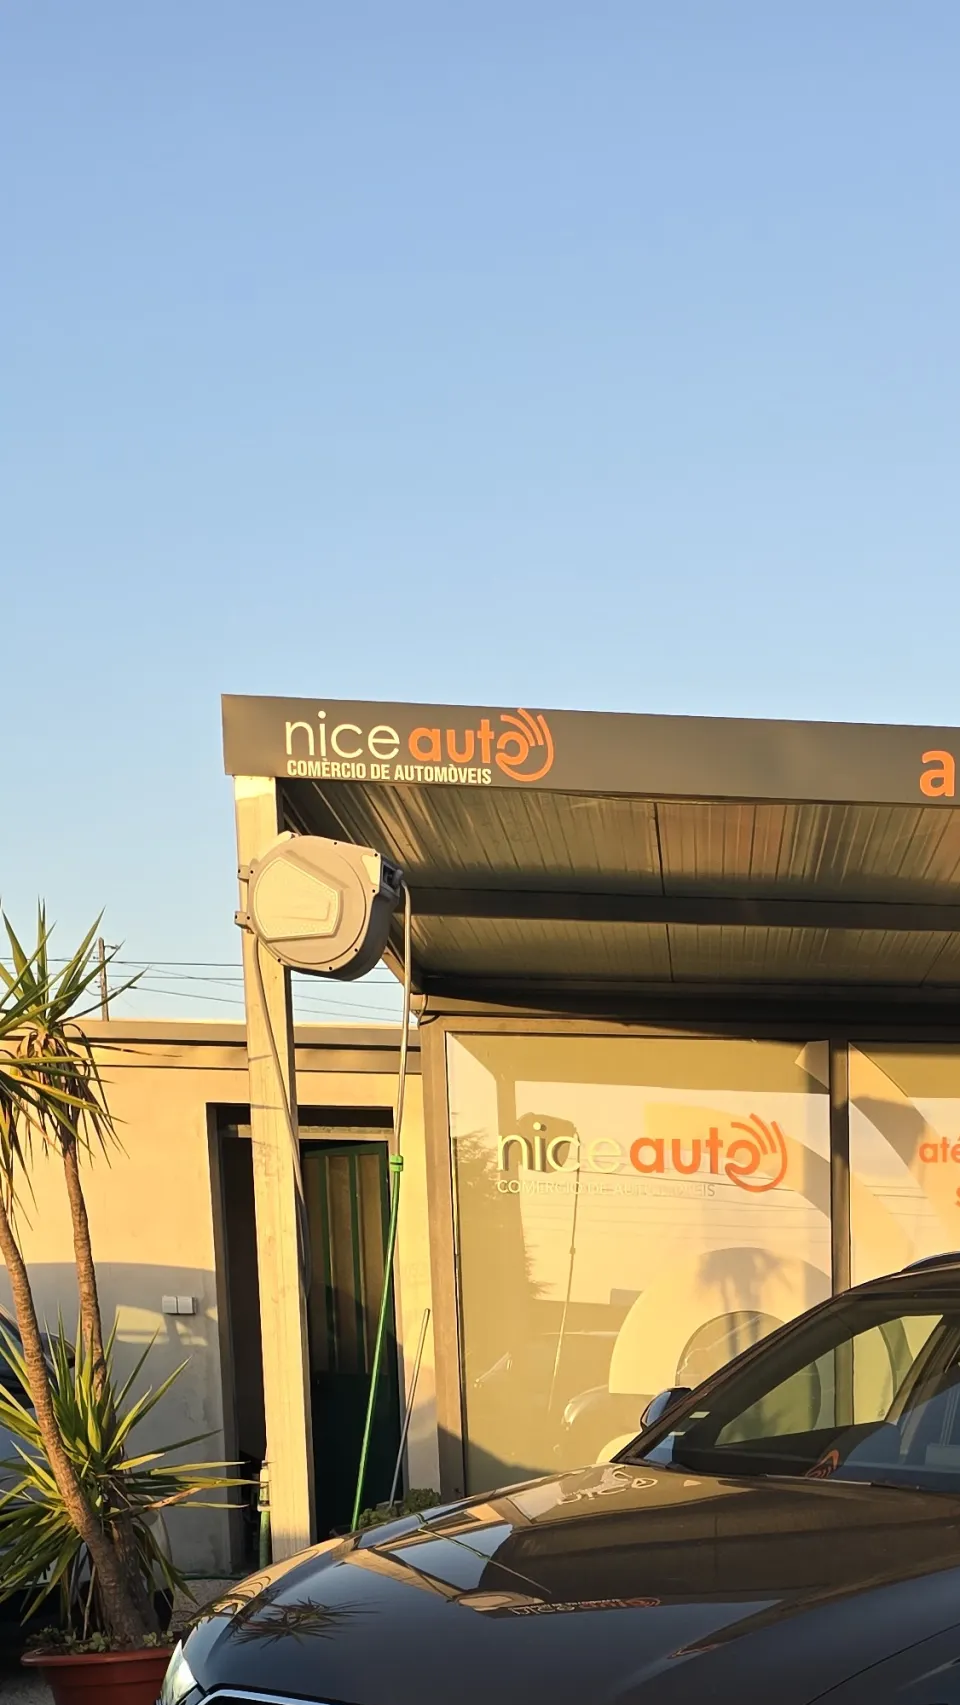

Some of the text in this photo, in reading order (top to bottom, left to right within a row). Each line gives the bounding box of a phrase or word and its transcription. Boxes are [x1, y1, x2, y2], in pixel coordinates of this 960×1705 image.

[284, 710, 400, 760] nice
[371, 763, 391, 780] DE
[919, 750, 955, 797] a
[498, 1121, 622, 1174] nice
